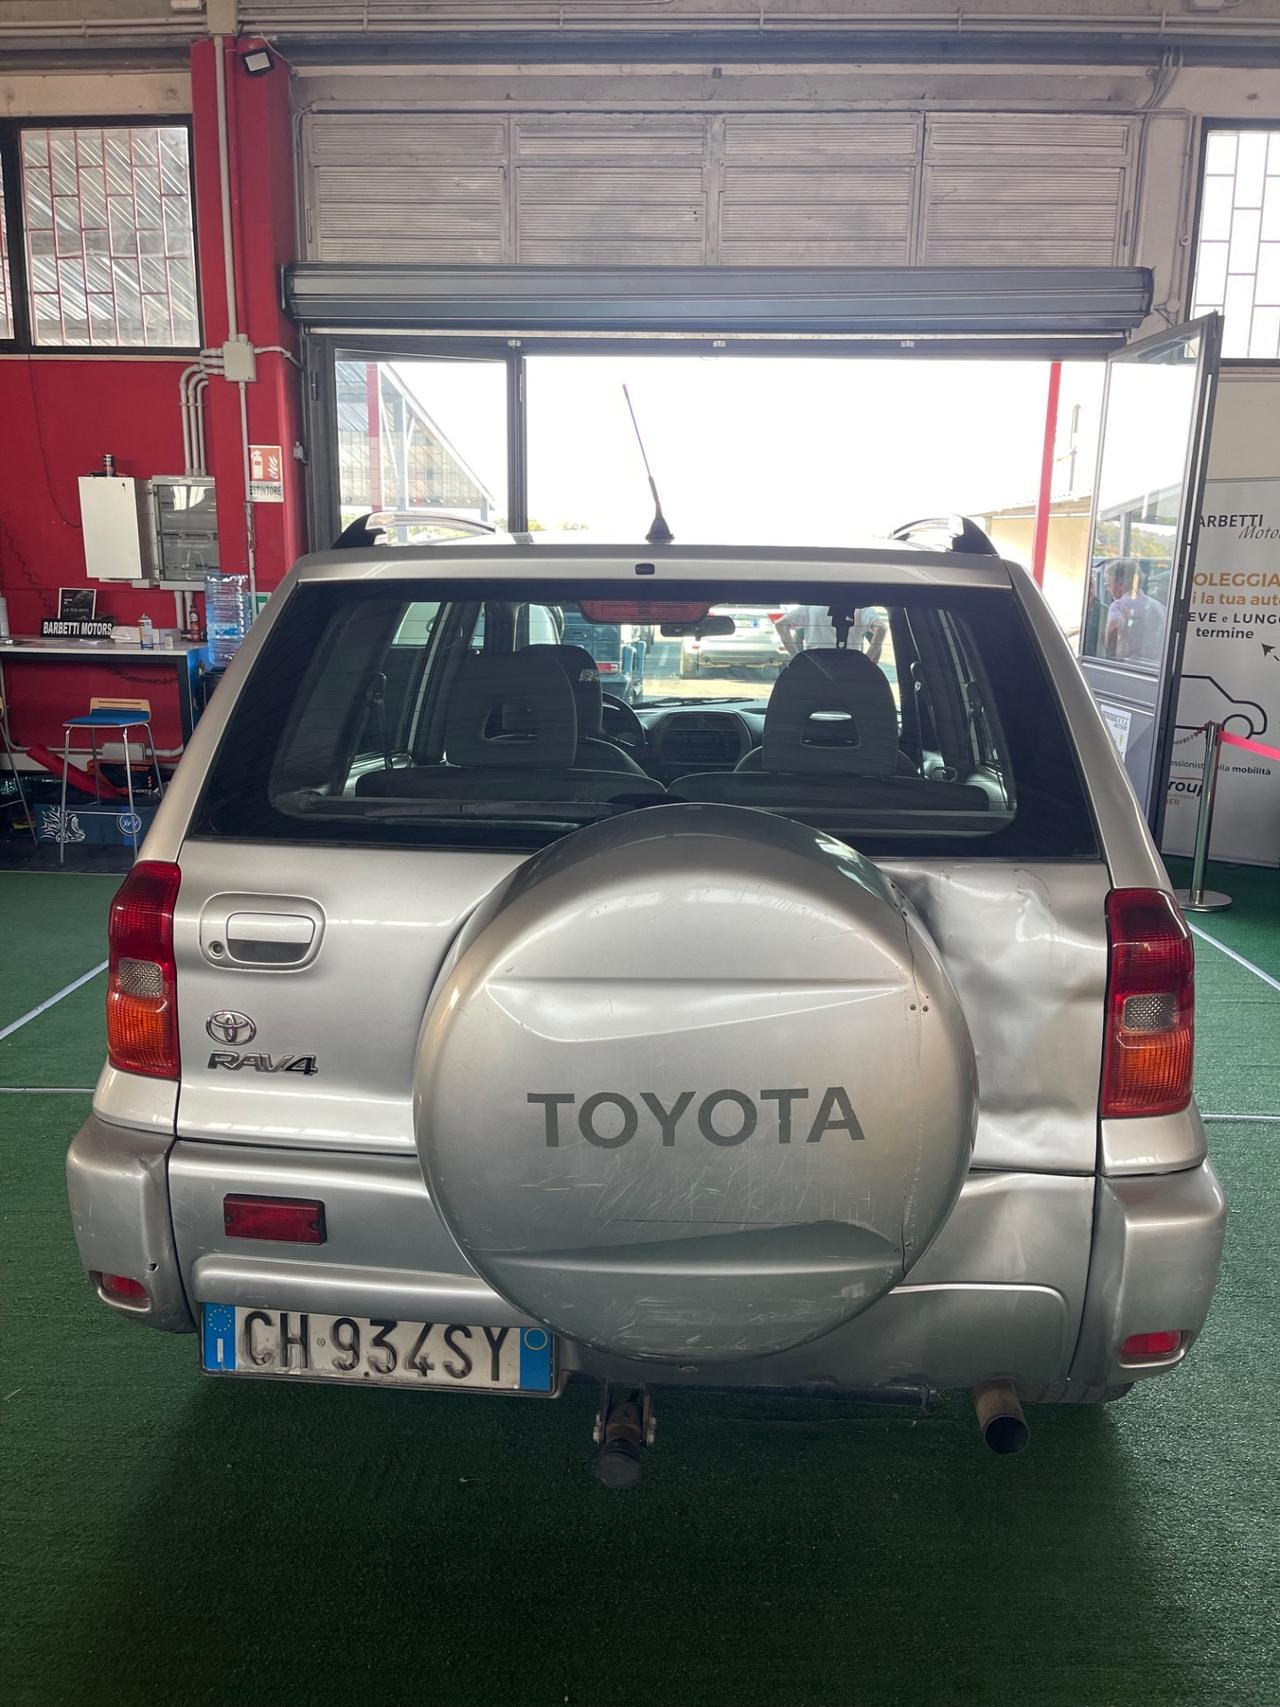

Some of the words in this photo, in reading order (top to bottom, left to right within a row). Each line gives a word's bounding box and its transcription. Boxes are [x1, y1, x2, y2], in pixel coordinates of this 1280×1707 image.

[250, 484, 281, 496] ESTINTORE
[1200, 514, 1263, 528] ARBETTI
[1238, 525, 1280, 540] Moto
[1194, 572, 1280, 588] OLEGGIA
[1201, 592, 1215, 605] la
[1220, 593, 1246, 606] tua
[1188, 611, 1217, 623] EVE
[1222, 615, 1228, 623] e
[1233, 613, 1280, 625] LUNG
[43, 621, 80, 635] BARBETTI
[81, 622, 113, 636] MOTORS
[1196, 627, 1254, 639] termine
[1232, 766, 1271, 776] mobilità
[207, 1050, 319, 1076] RAV4
[527, 1086, 866, 1149] TOYOTA
